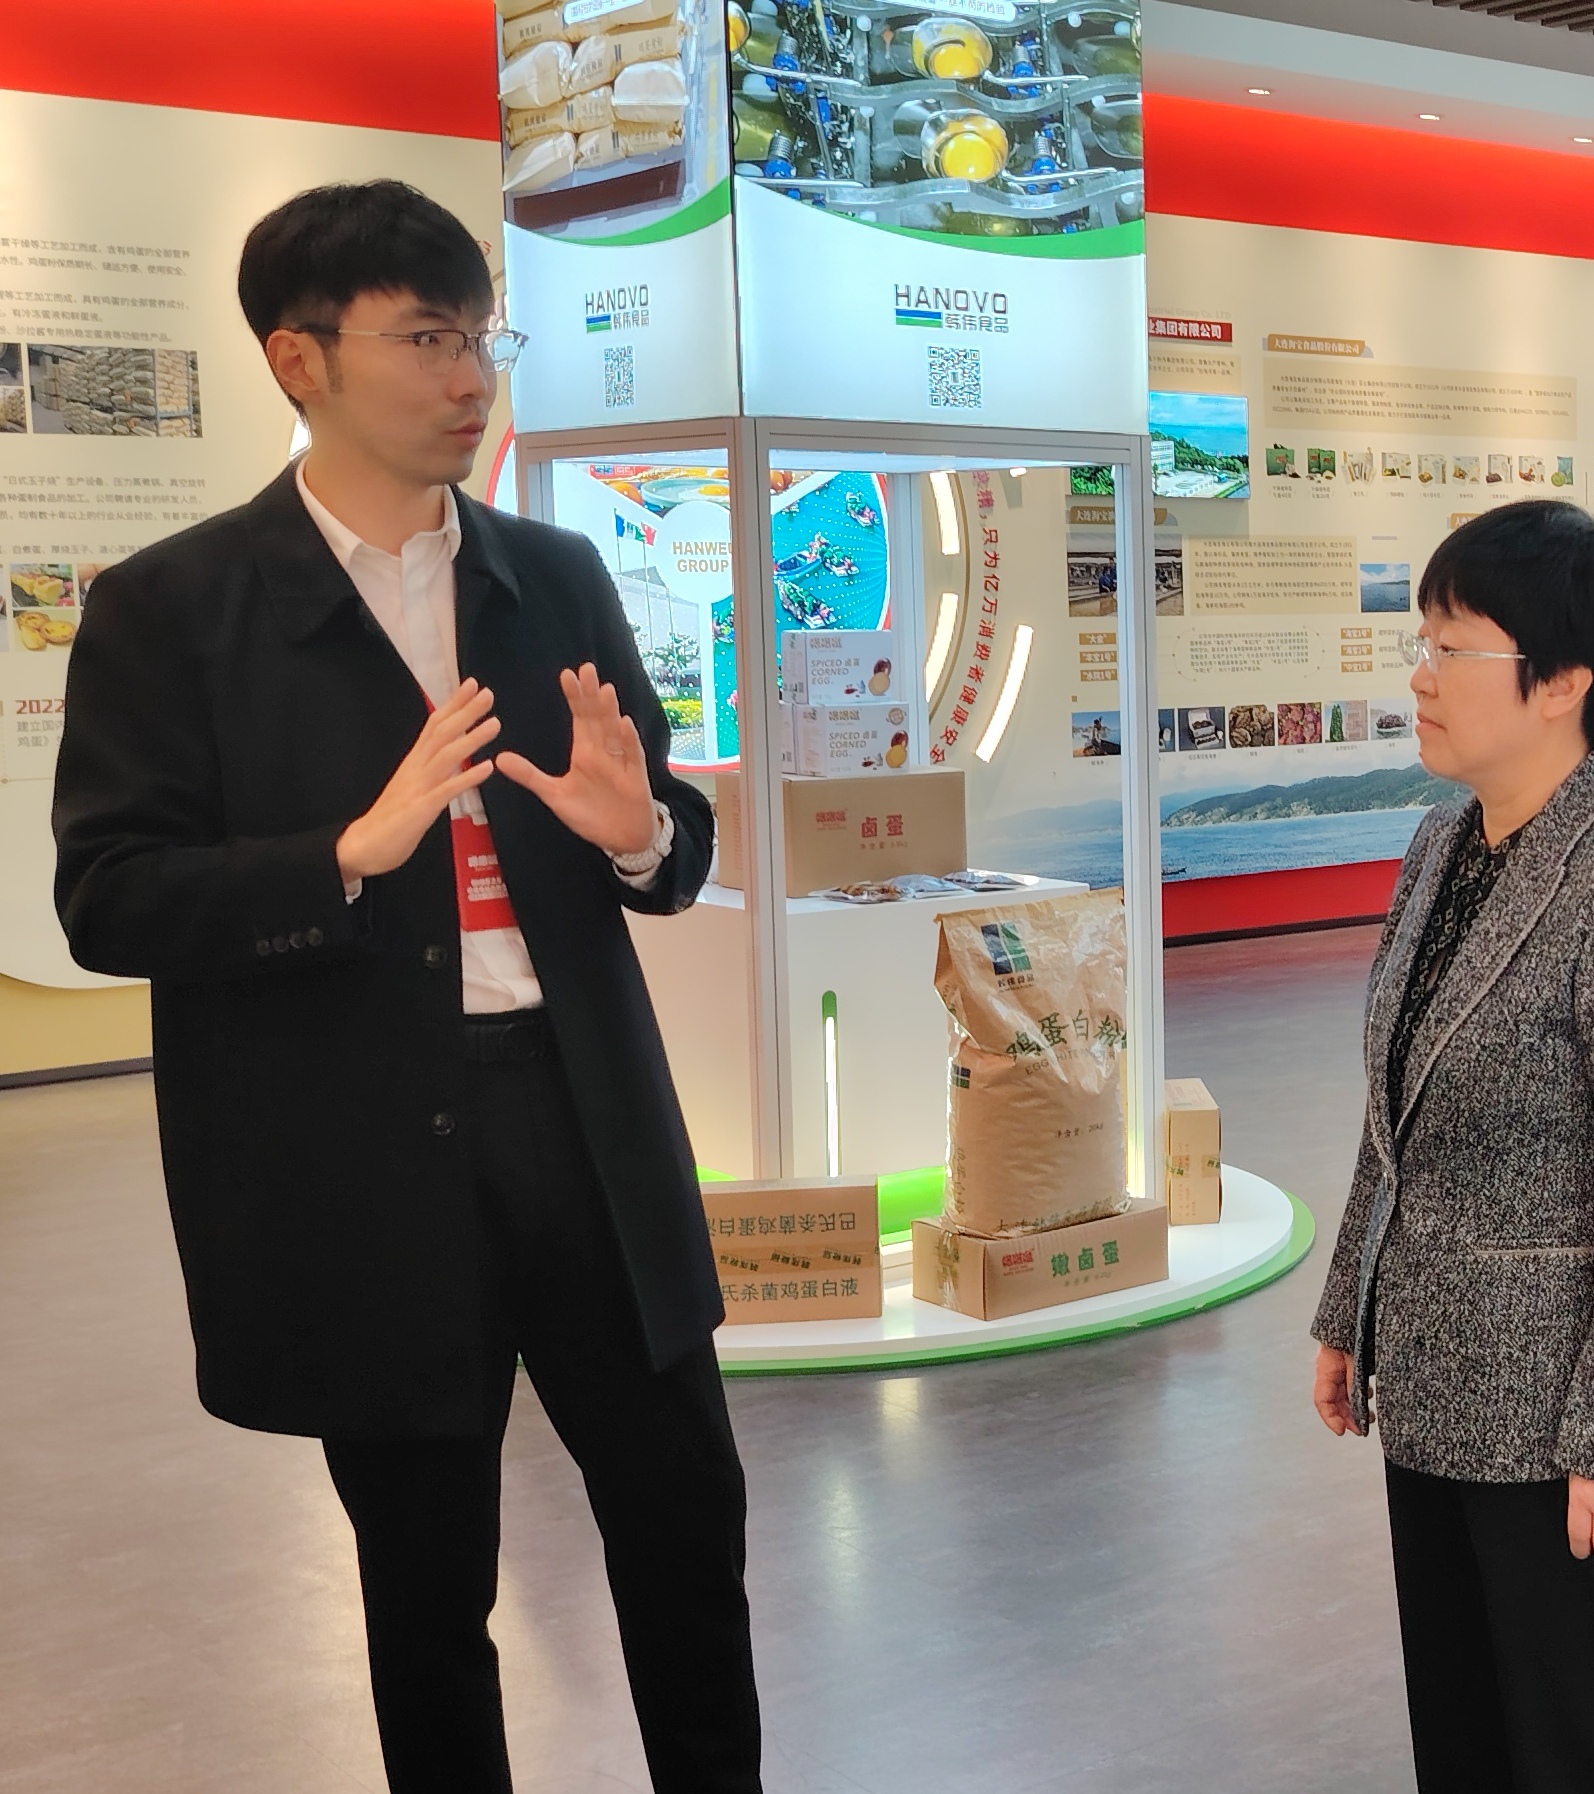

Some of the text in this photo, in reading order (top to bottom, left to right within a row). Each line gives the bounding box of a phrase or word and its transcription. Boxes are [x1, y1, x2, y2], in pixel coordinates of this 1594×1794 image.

[585, 284, 649, 315] HANOVO
[894, 284, 1008, 315] HANOVO
[677, 558, 730, 573] GROUP
[811, 659, 842, 668] SPICED
[811, 668, 849, 677] CORNED
[15, 699, 65, 715] 2022
[828, 731, 860, 741] SPICED
[829, 741, 867, 750] CORNED
[861, 814, 904, 839] 卤蛋
[1024, 1058, 1050, 1075] EGG
[1056, 1047, 1079, 1062] HITE
